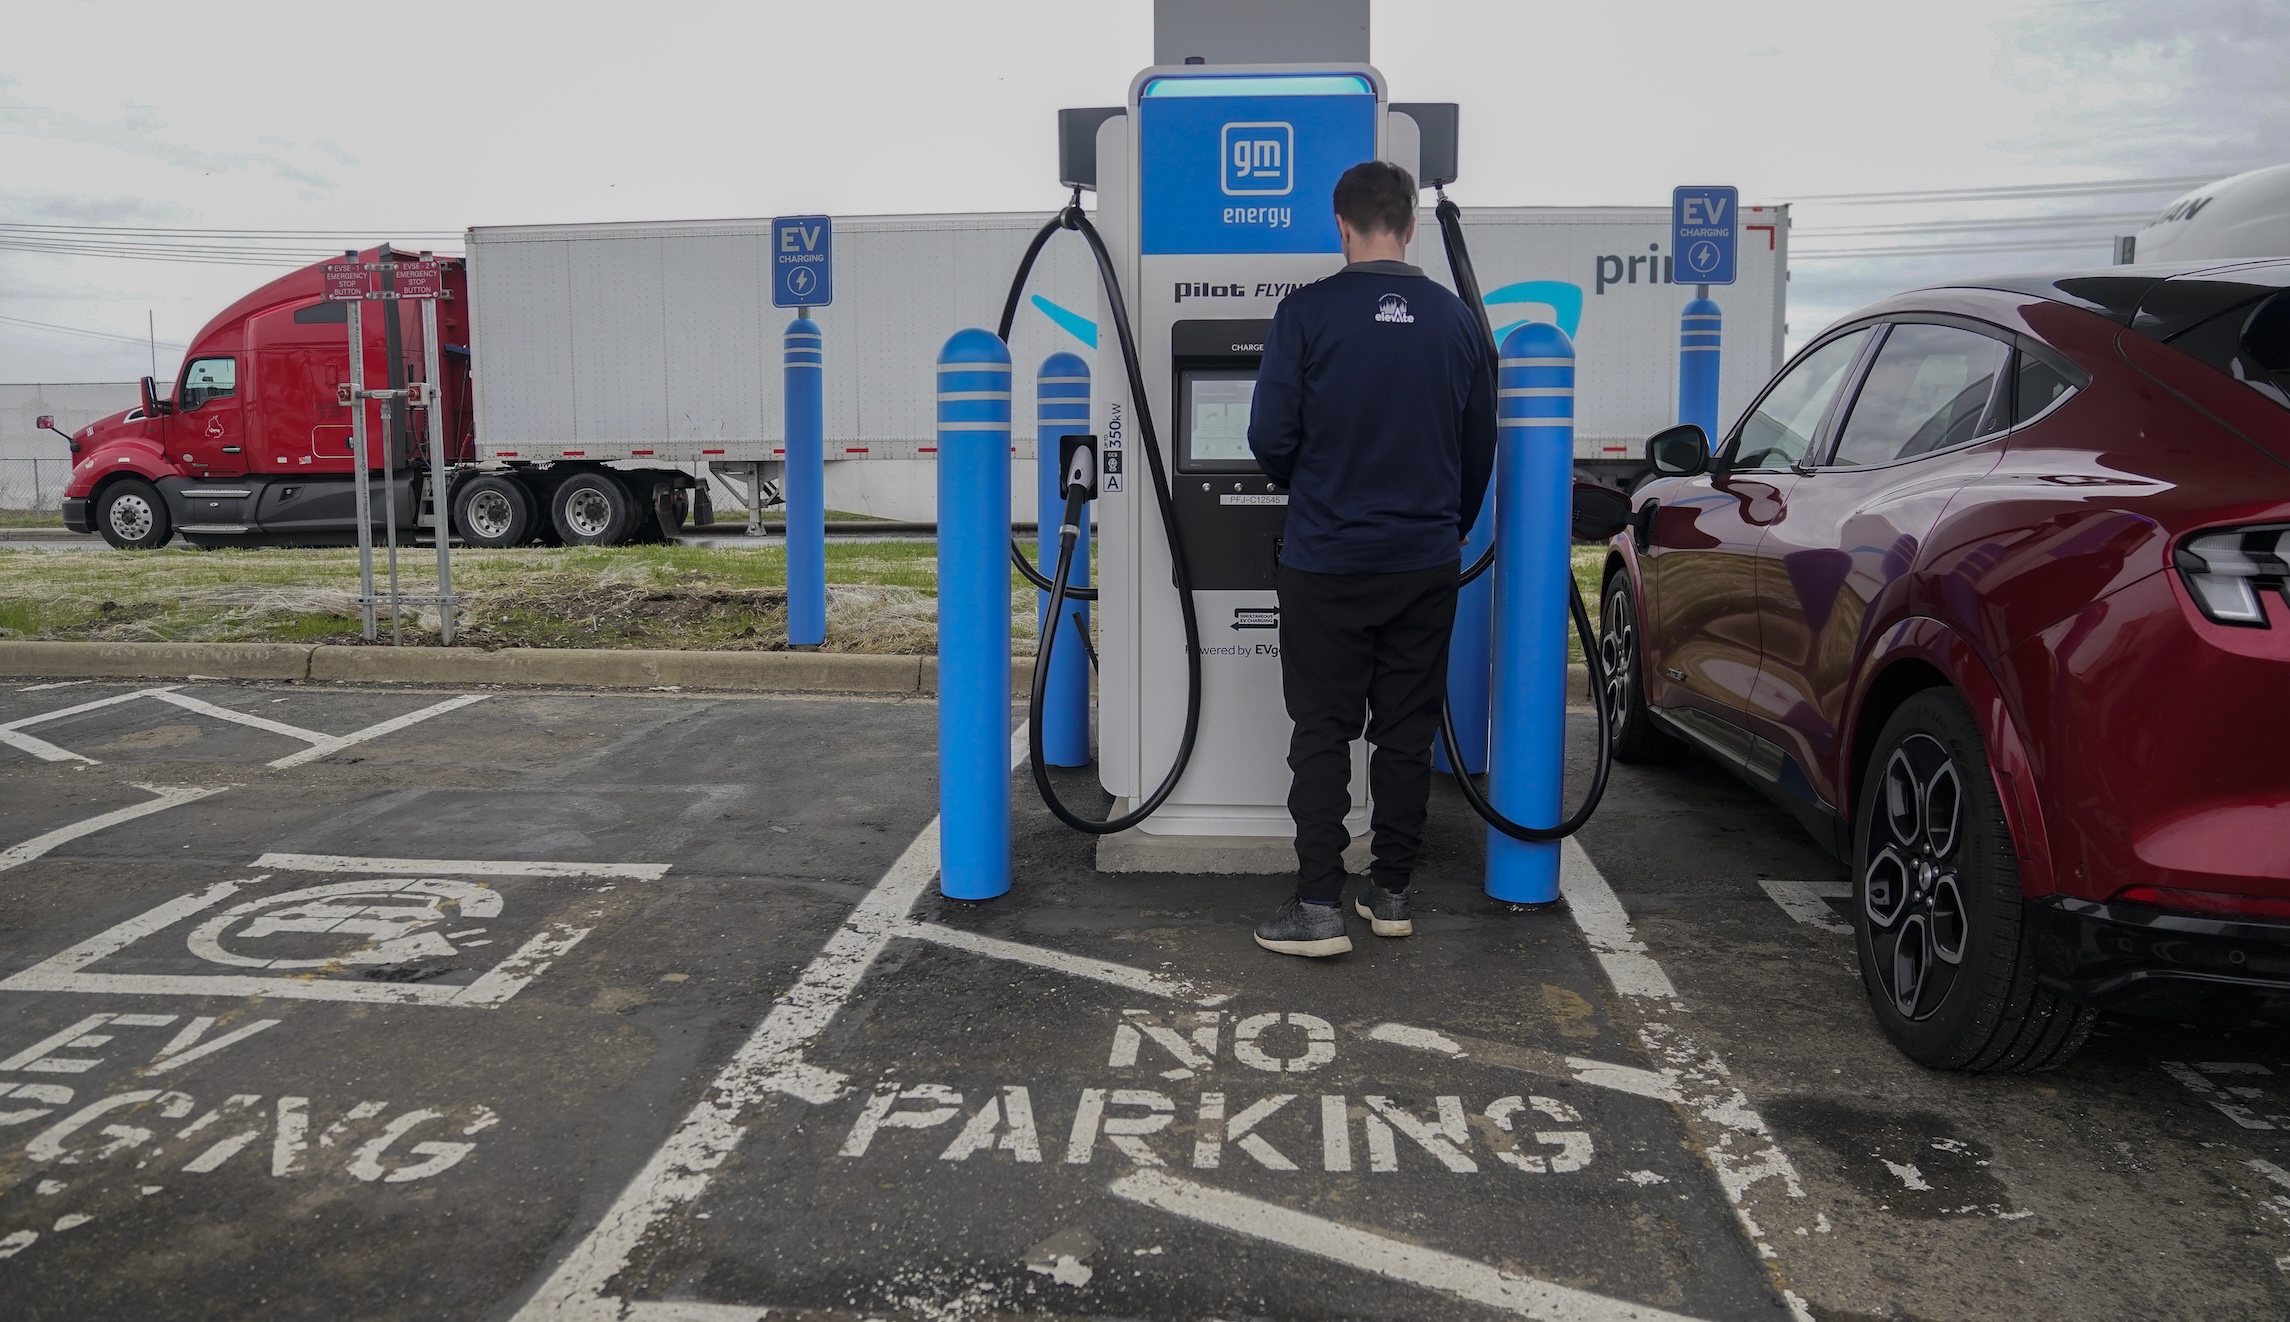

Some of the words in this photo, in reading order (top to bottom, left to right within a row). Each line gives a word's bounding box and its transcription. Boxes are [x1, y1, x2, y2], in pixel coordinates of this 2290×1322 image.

[1234, 140, 1281, 177] gm
[1223, 207, 1291, 228] energy
[1683, 198, 1727, 225] EV
[781, 226, 821, 252] EV
[1680, 228, 1730, 237] CHARGING
[779, 254, 824, 263] CHARGING
[327, 272, 368, 280] EMERGENCY
[396, 270, 438, 278] EMERGENCY
[1596, 243, 1672, 295] pri
[1231, 343, 1265, 351] CHARGE
[1109, 403, 1121, 448] 350kW
[1107, 475, 1119, 489] A
[1230, 495, 1281, 504] PFJ-C12545
[1237, 645, 1252, 657] by
[1255, 644, 1280, 657] EVg
[1108, 1009, 1336, 1081] NO
[837, 1083, 1594, 1174] PARKING
